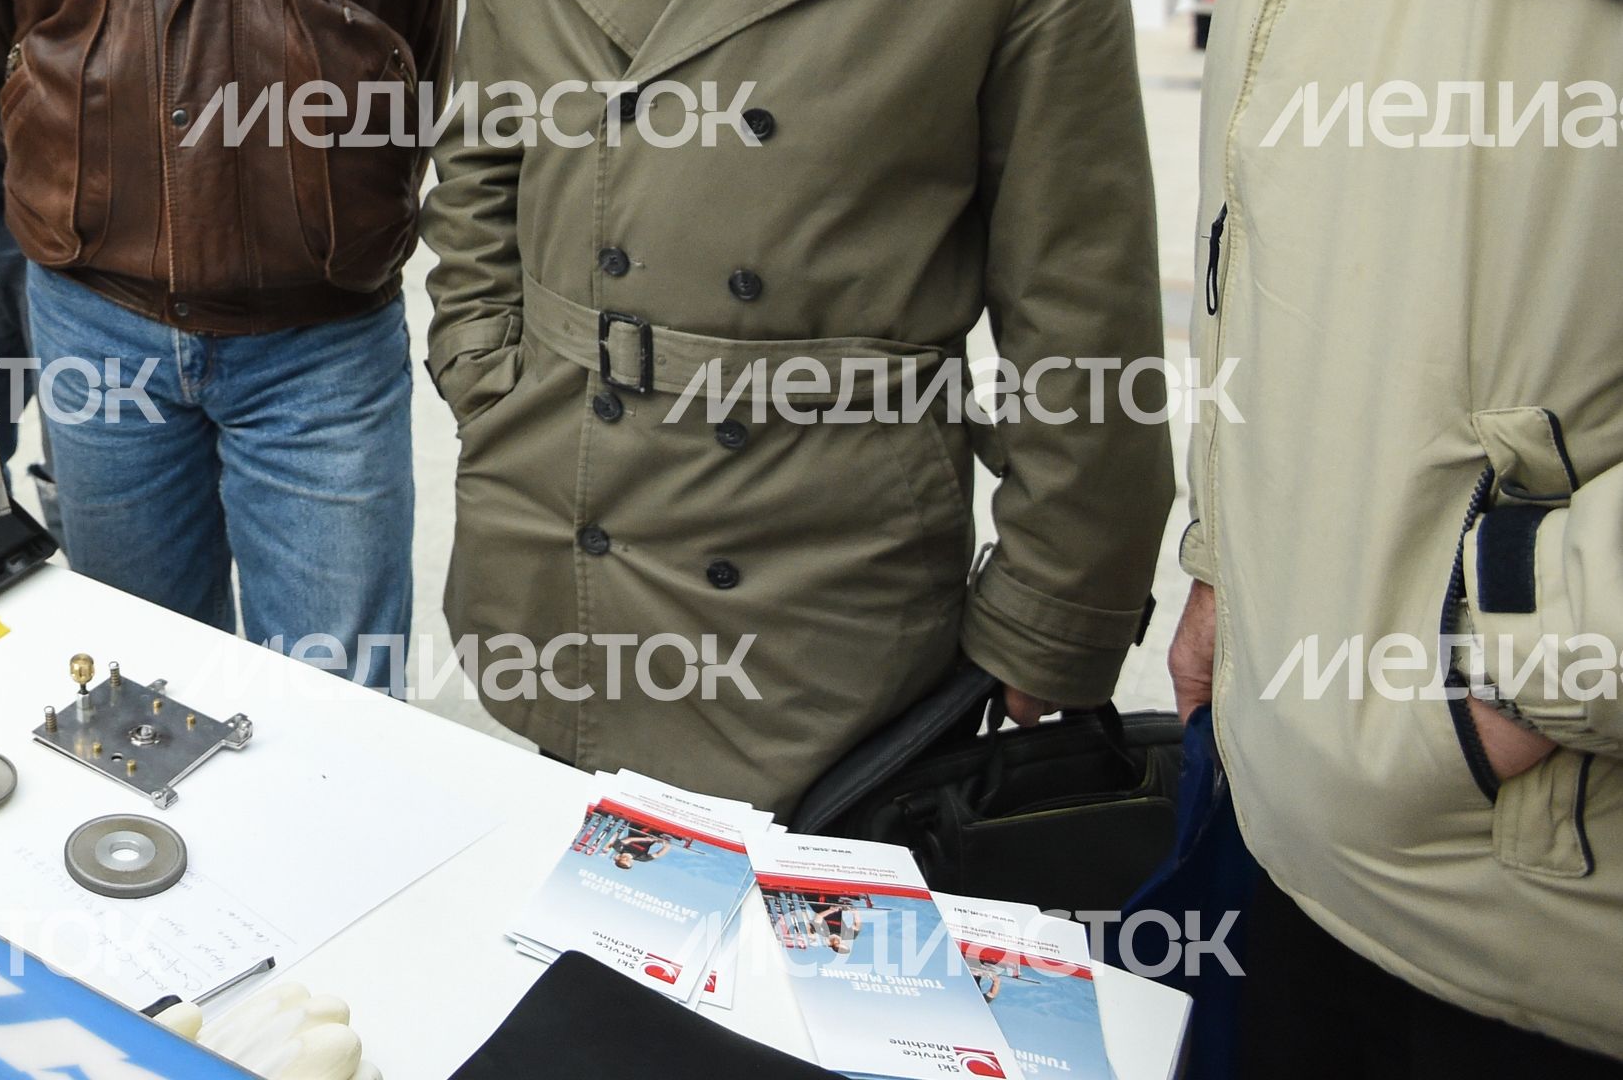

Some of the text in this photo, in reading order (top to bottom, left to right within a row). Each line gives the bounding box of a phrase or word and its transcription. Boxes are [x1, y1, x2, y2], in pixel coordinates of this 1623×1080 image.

[578, 867, 700, 920] ЗАТОЧКИ КАНТОВ
[614, 891, 688, 924] МАШИНКА
[592, 930, 644, 956] Machine
[595, 940, 640, 963] Service
[617, 957, 636, 970] Ski
[820, 967, 946, 991] TUNING MACHINE
[852, 981, 922, 998] SKI EDGE
[889, 1038, 951, 1053] Machine
[902, 1049, 956, 1063] Service
[938, 1063, 961, 1074] Ski
[1015, 1049, 1072, 1072] TUNIN
